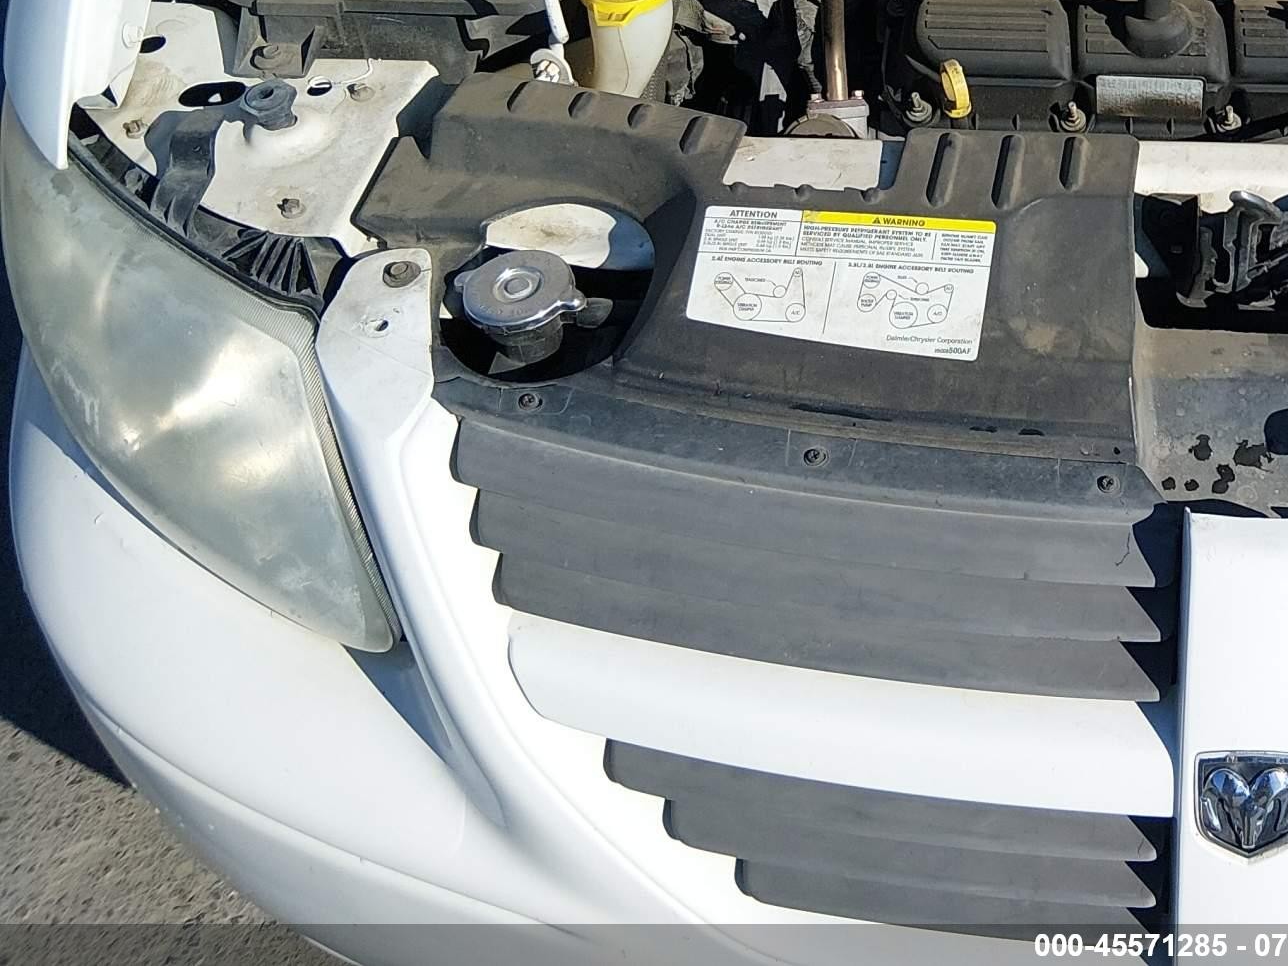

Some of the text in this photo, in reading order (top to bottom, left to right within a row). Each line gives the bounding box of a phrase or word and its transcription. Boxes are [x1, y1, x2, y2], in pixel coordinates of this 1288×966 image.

[729, 209, 778, 219] ATTENTION
[883, 218, 925, 227] WARNING
[937, 336, 973, 345] Corporation
